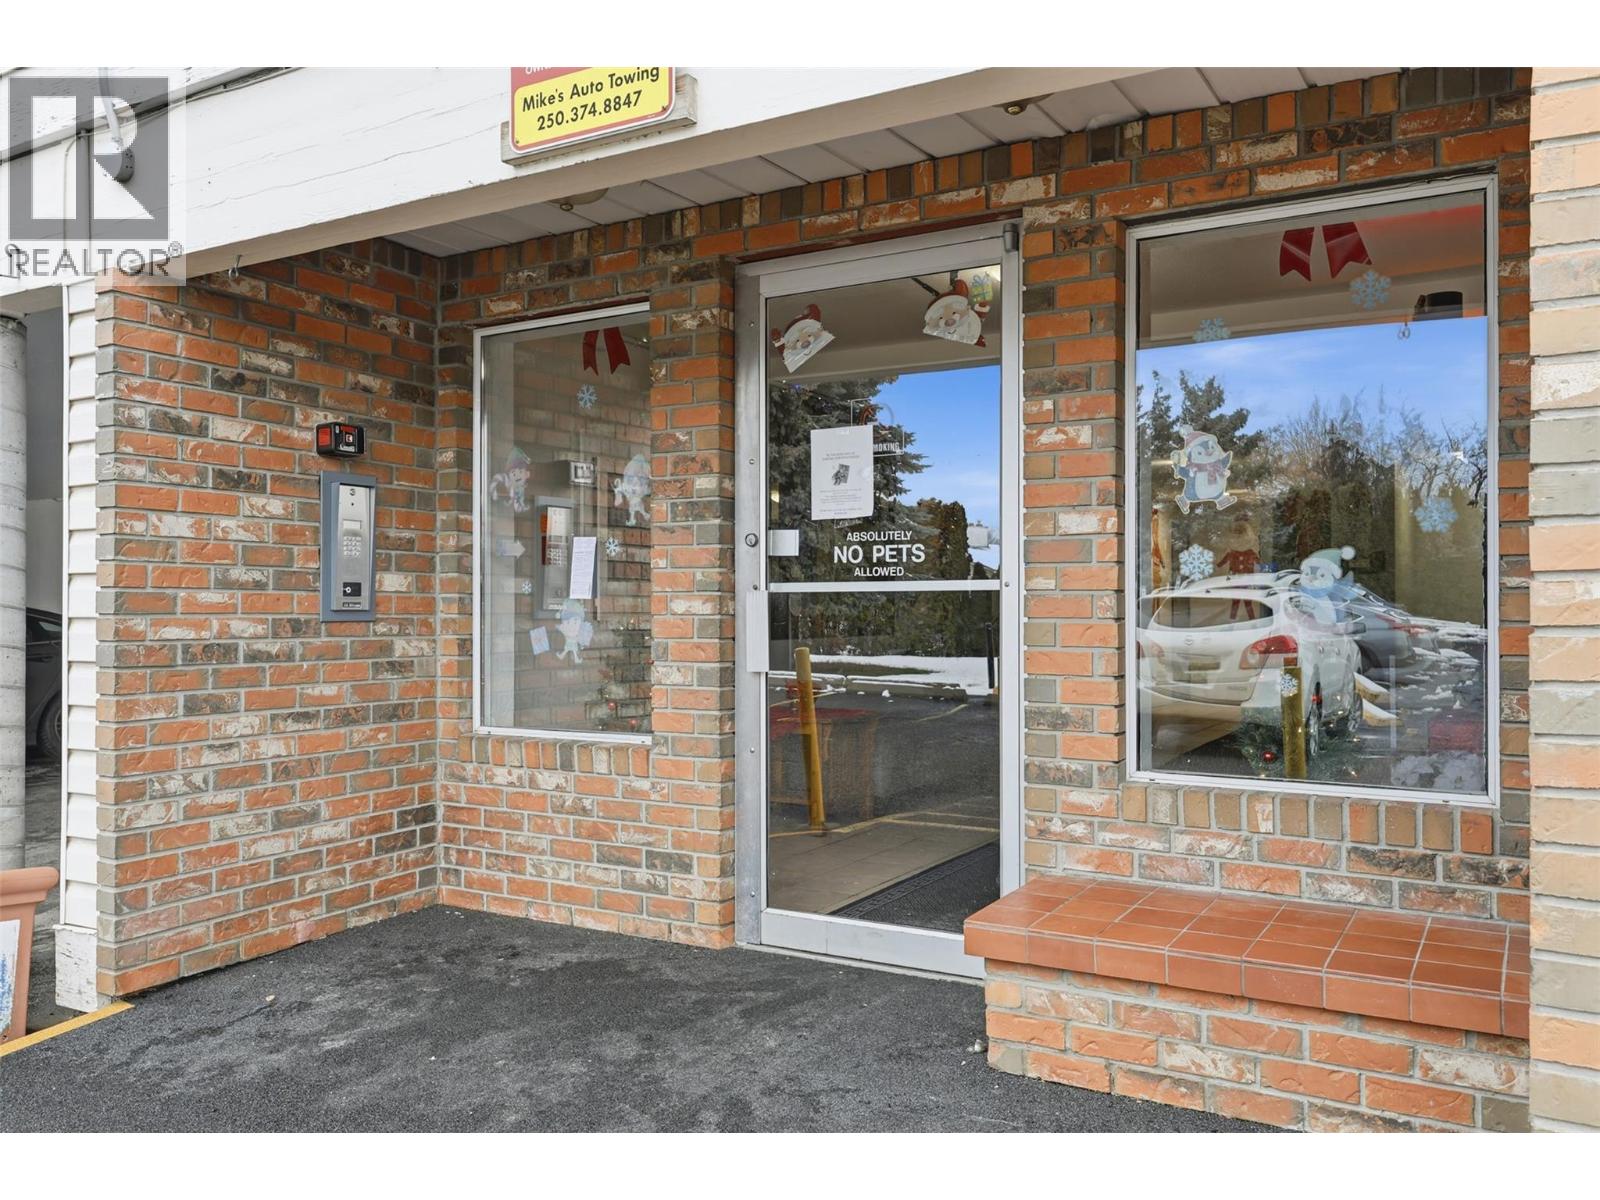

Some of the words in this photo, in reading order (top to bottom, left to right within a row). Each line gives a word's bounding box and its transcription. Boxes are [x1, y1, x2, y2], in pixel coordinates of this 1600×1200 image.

[522, 88, 564, 112] Mike's
[570, 83, 604, 99] Auto
[608, 67, 660, 89] Towing
[537, 89, 643, 131] 250.374.8847
[873, 441, 900, 452] MOKING
[846, 530, 912, 542] ABSOLUTELY
[833, 544, 864, 564] NO
[872, 543, 926, 563] PETS
[853, 566, 905, 577] ALLOWED
